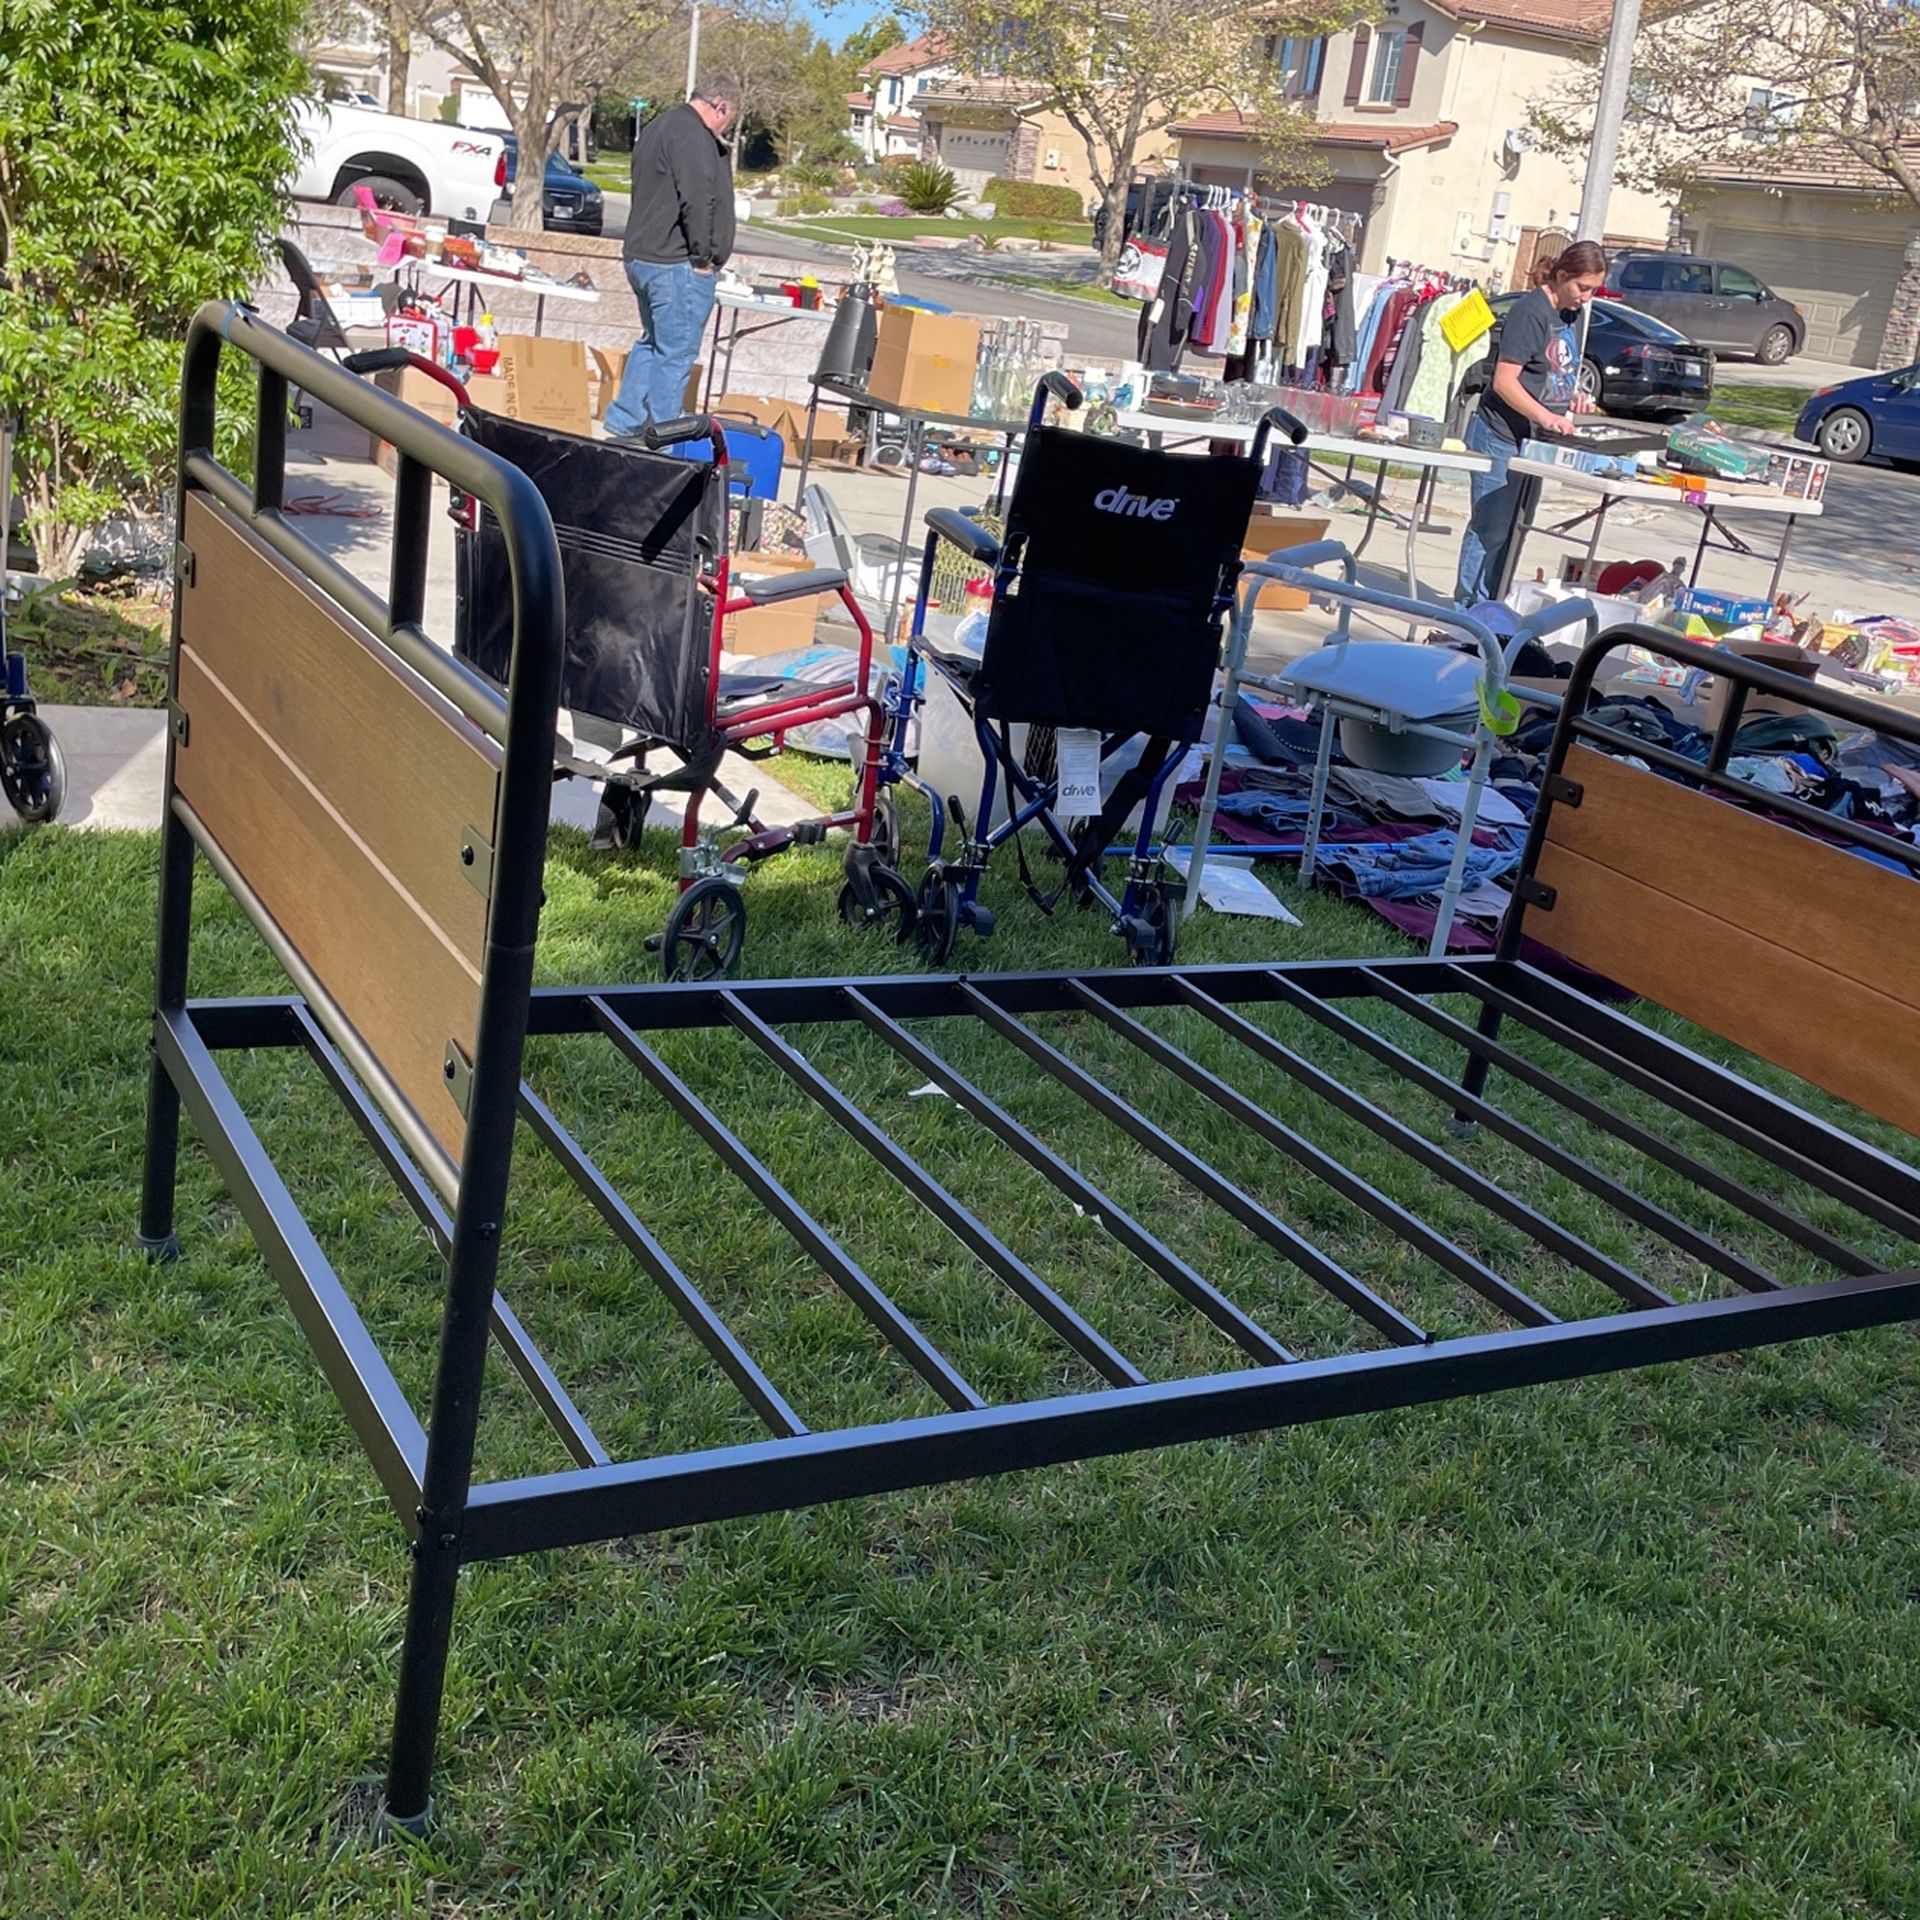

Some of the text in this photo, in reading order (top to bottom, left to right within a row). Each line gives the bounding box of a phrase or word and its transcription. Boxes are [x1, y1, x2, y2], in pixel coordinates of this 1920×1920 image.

[451, 140, 492, 156] FX4
[502, 356, 516, 389] MADE
[505, 393, 517, 404] IN
[1094, 485, 1176, 521] drive
[1062, 784, 1096, 797] drive
